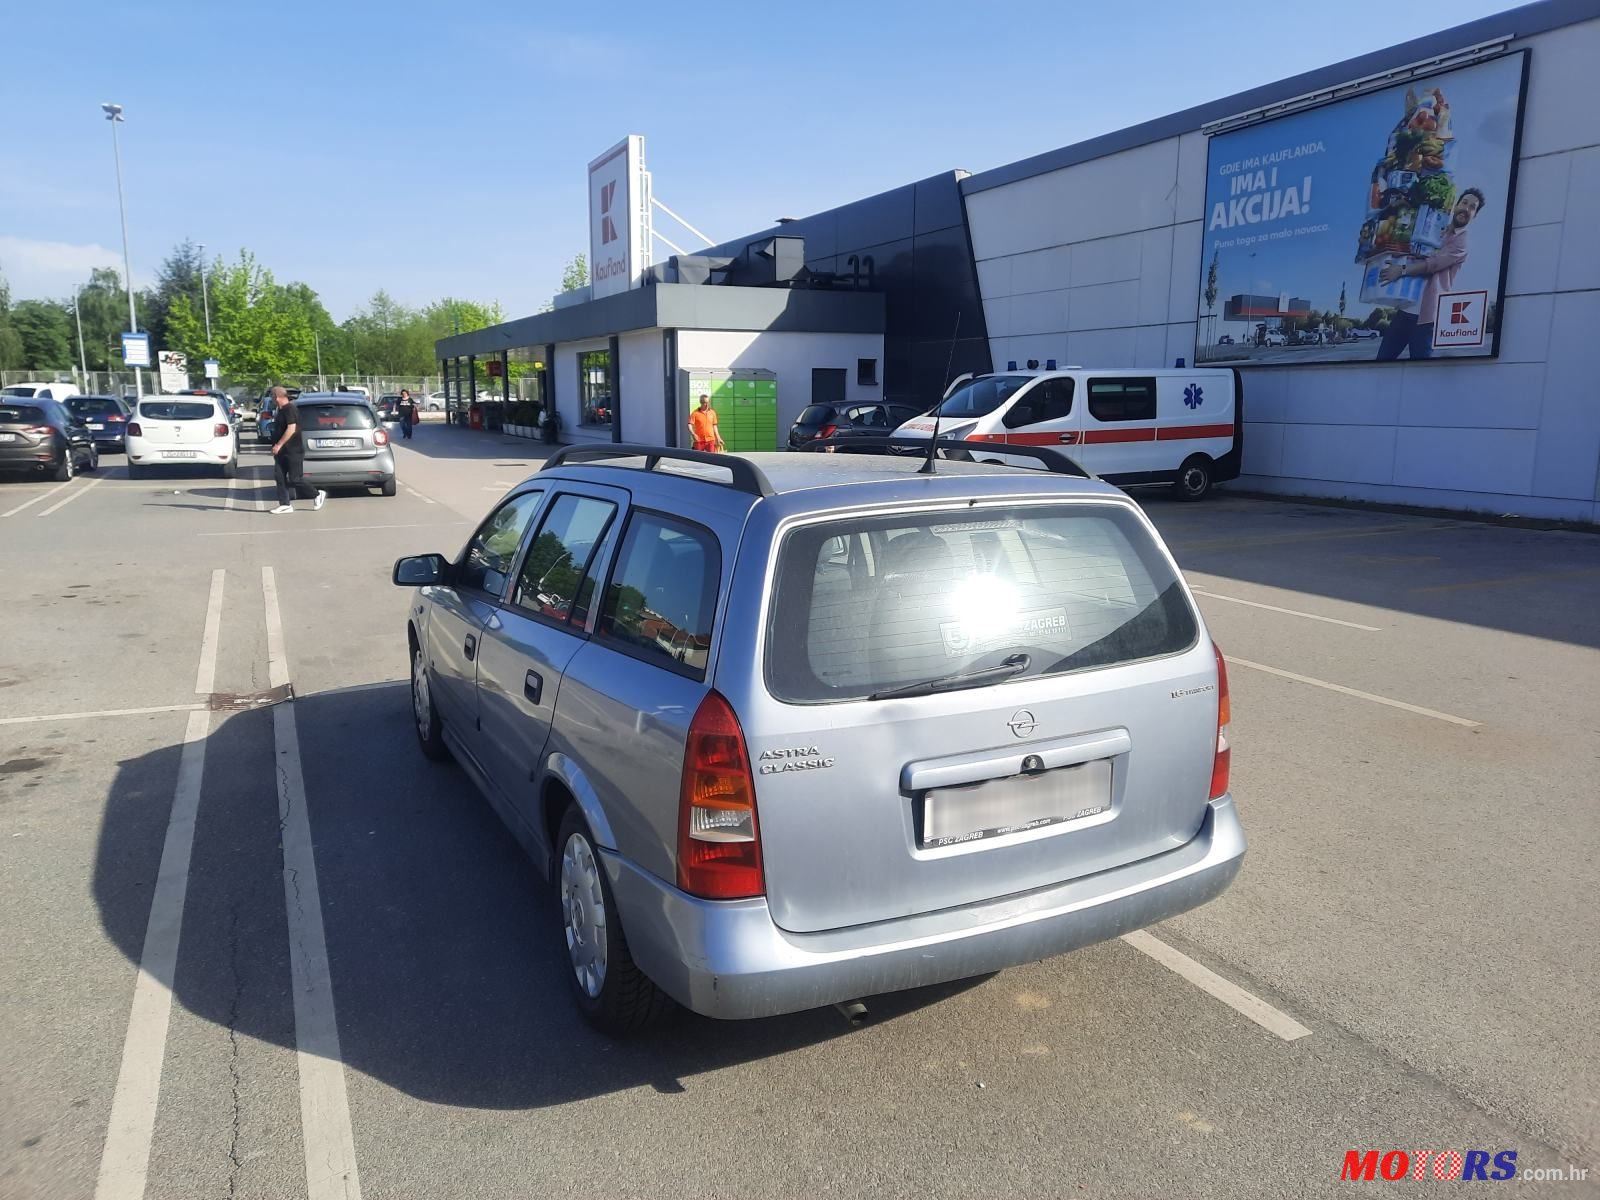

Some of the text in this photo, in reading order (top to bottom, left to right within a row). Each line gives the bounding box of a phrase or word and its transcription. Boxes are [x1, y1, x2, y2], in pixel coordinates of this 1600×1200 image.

[1219, 141, 1326, 176] GDJE IMA KAUFLANDA,
[1230, 167, 1278, 196] IMA I
[1209, 175, 1312, 231] AKCIJA!
[1214, 238, 1235, 249] Puno
[1236, 234, 1257, 247] toga
[1258, 233, 1269, 242] za
[1270, 228, 1293, 240] malo
[595, 251, 626, 281] Kaufland
[1440, 328, 1478, 337] Kaufland
[1024, 615, 1066, 631] ZAGREB
[759, 745, 820, 761] ASTRA
[759, 757, 835, 774] CLASSIC
[1076, 806, 1102, 818] ZAGREB
[938, 831, 984, 846] PSC ZAGREB
